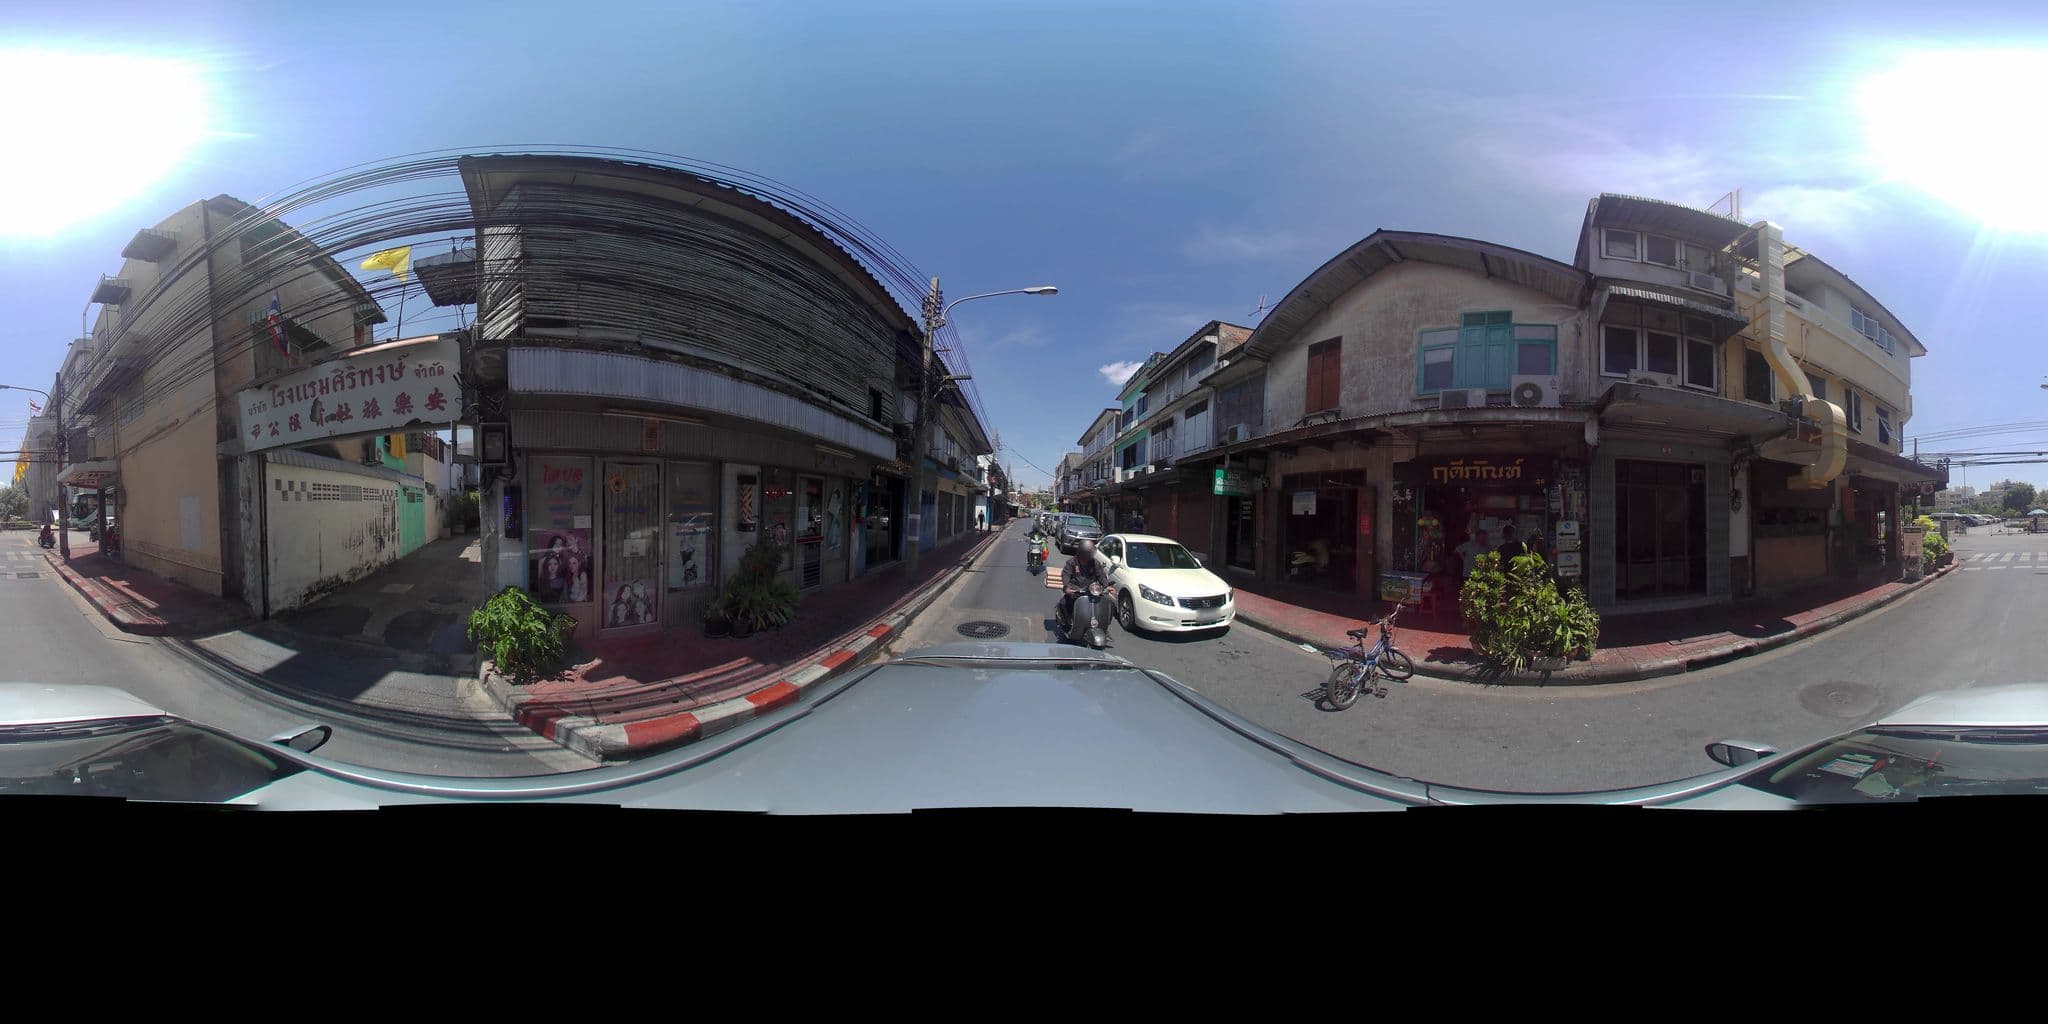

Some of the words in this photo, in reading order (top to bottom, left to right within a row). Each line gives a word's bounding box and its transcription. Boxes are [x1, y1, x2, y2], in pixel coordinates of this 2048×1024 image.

[271, 354, 409, 408] โรงแรมศิริพงษ์
[414, 361, 445, 379] จำกัด
